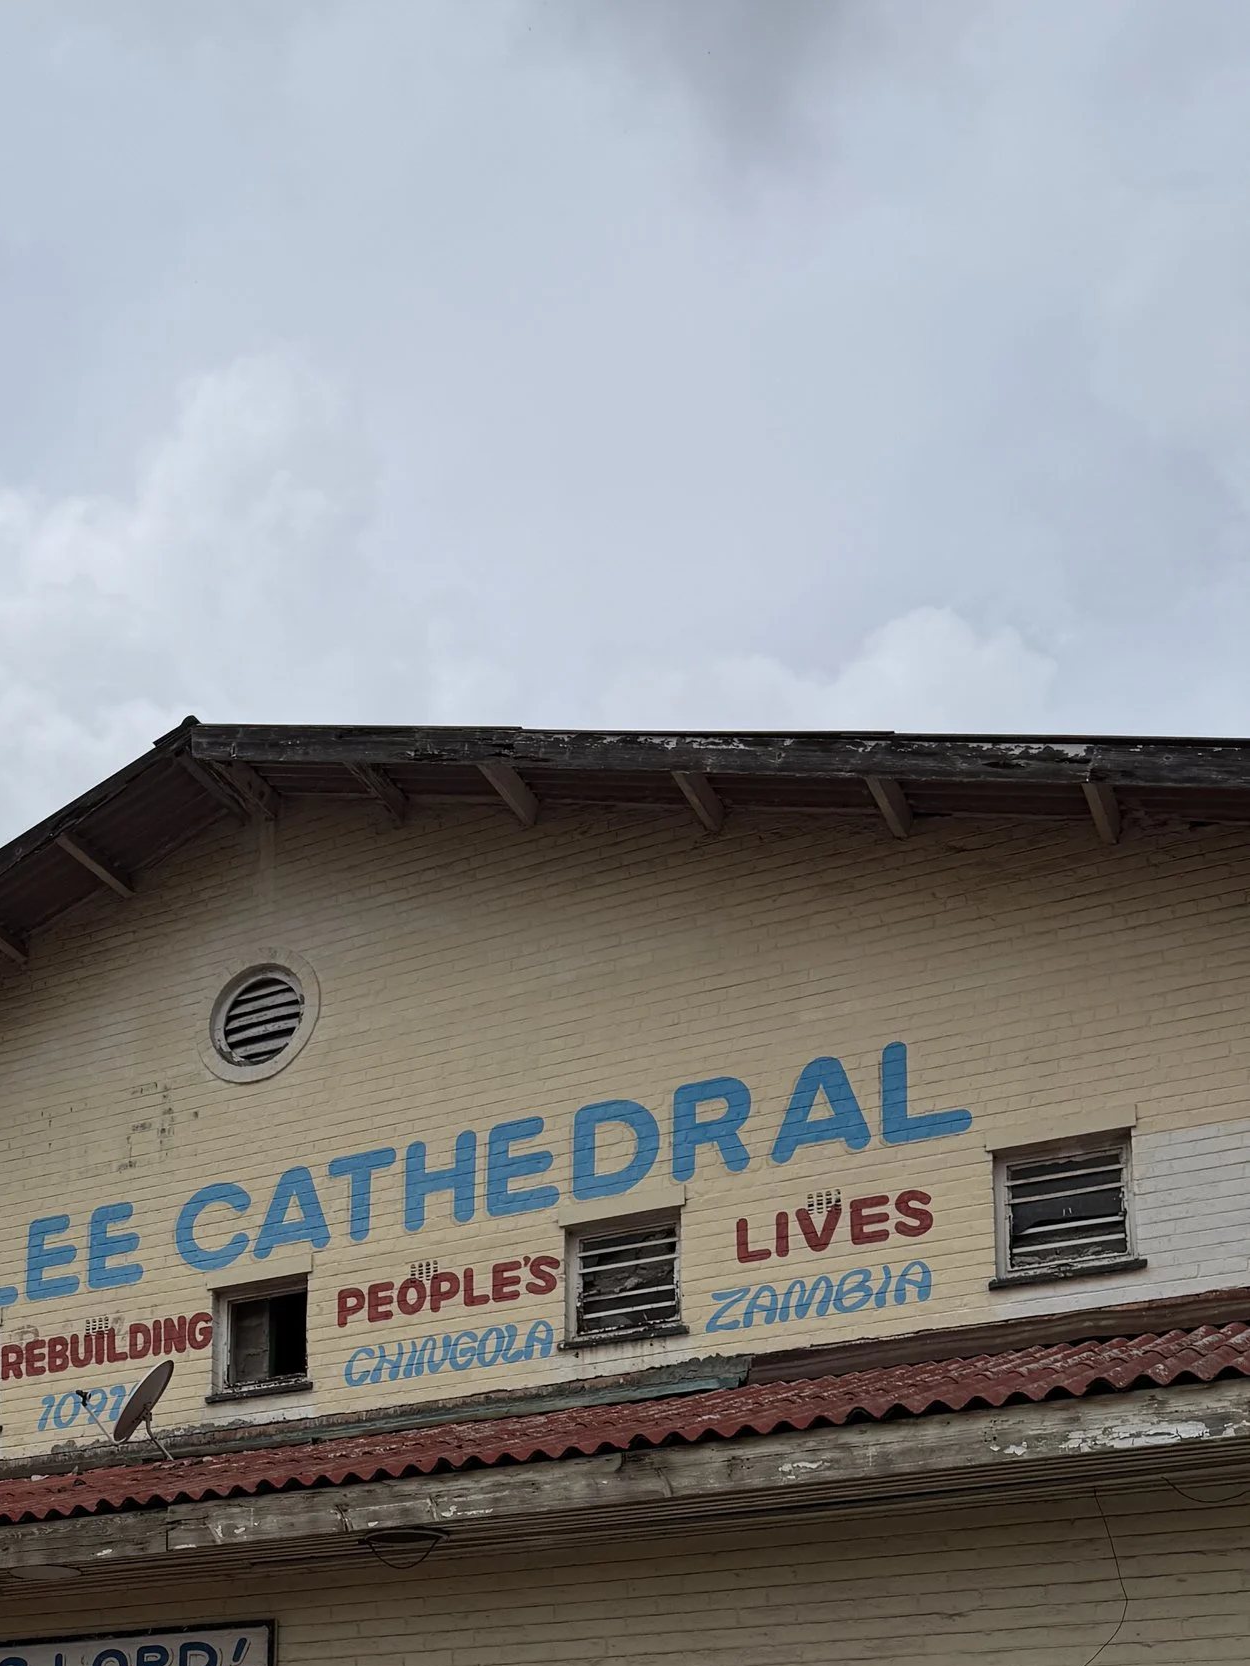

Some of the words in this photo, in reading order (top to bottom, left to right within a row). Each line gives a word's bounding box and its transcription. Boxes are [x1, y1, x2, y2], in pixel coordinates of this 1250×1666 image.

[175, 1042, 973, 1271] CATHEDRAL
[1, 1312, 213, 1381] REBUILDING
[337, 1255, 561, 1328] PEOPLE'S
[736, 1190, 934, 1264] LIVES
[344, 1319, 554, 1388] CHINGOLA
[705, 1260, 932, 1334] ZAMBIA
